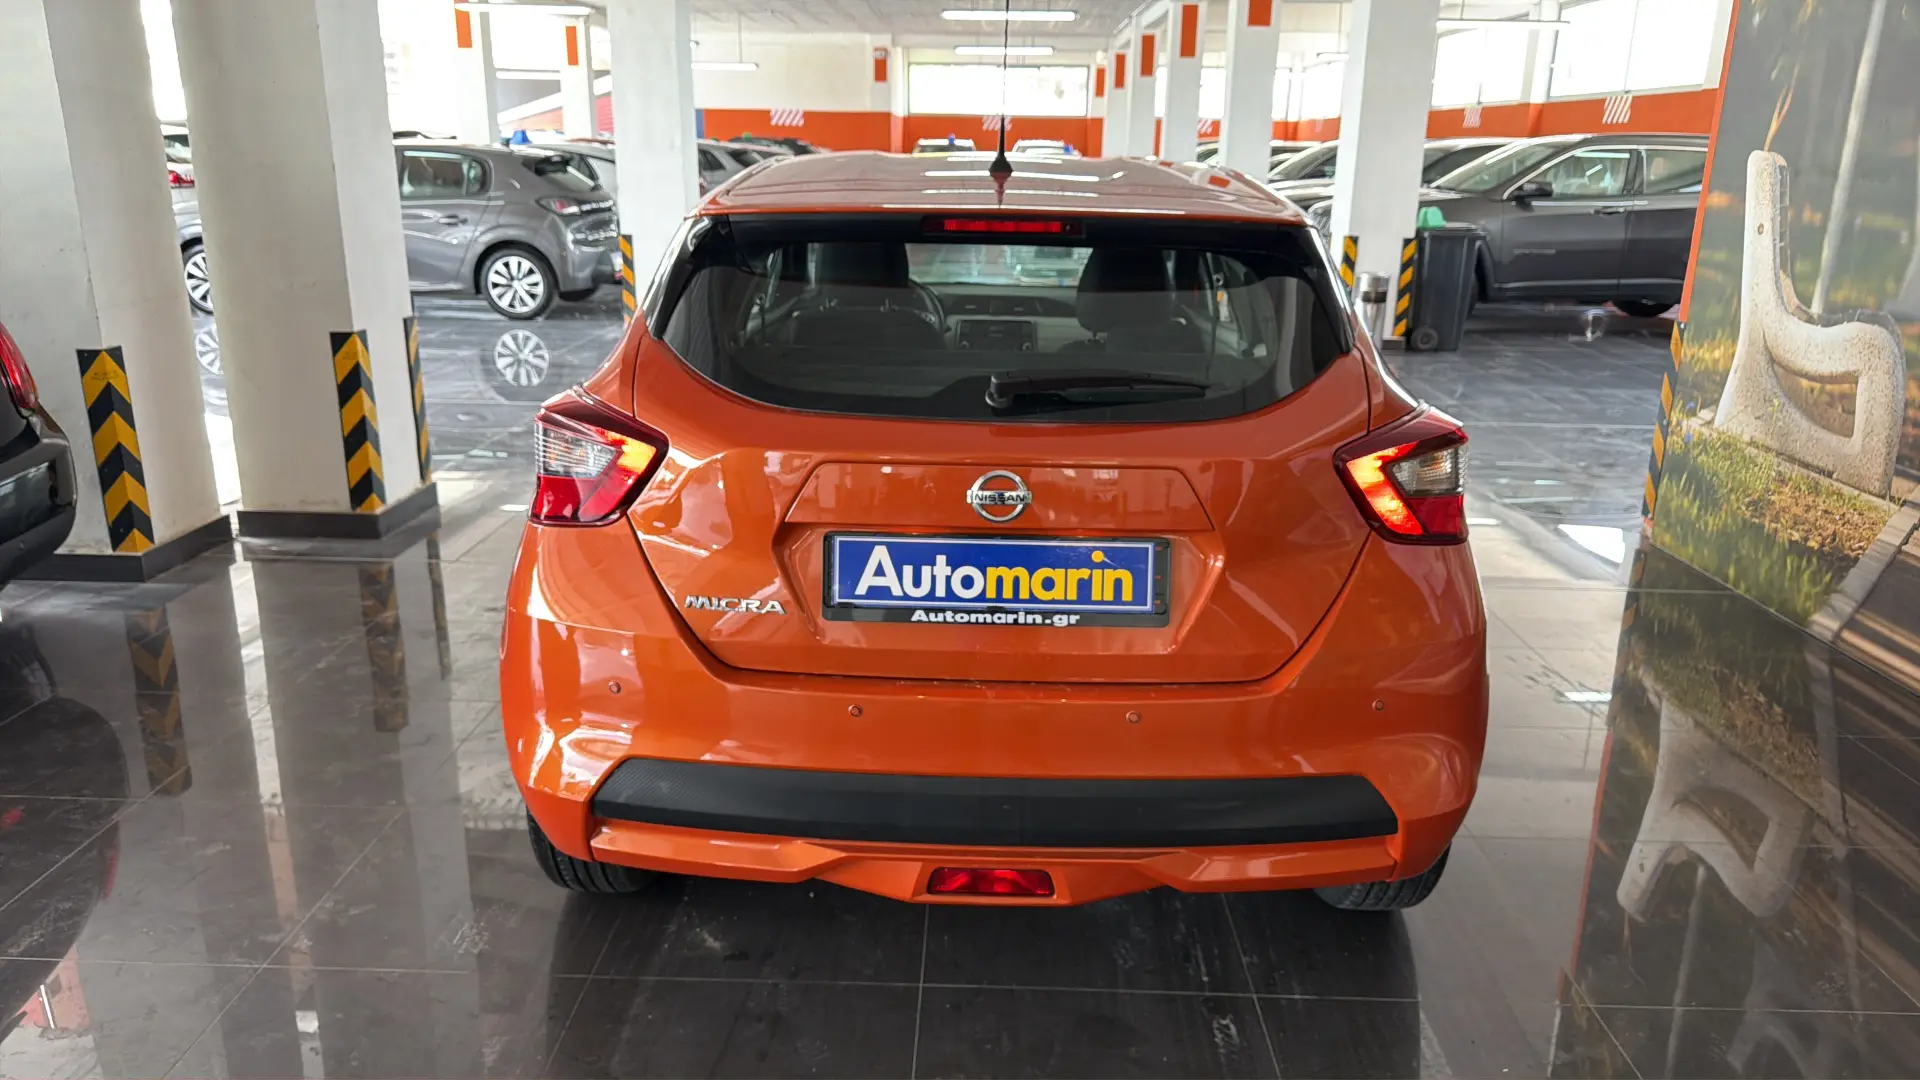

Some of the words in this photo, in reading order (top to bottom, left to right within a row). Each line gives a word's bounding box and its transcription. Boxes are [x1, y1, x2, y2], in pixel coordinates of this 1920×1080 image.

[974, 493, 1026, 504] NISSAN
[854, 545, 1133, 602] Automarin
[684, 594, 787, 614] MICRA
[910, 609, 1080, 627] Automarin.gr
